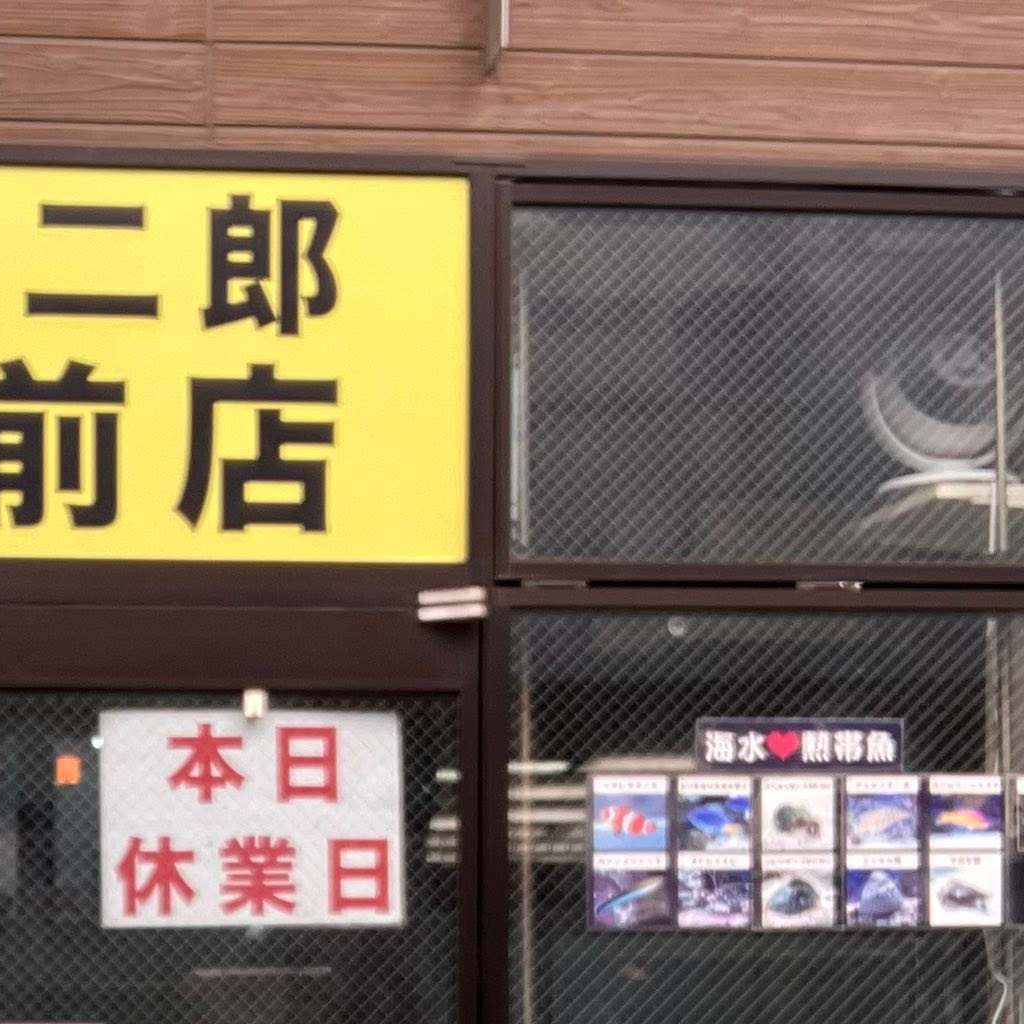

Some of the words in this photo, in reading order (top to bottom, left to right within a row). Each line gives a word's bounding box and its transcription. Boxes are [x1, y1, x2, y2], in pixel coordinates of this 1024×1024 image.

[166, 722, 342, 806] 本日
[116, 834, 392, 917] 休業日
